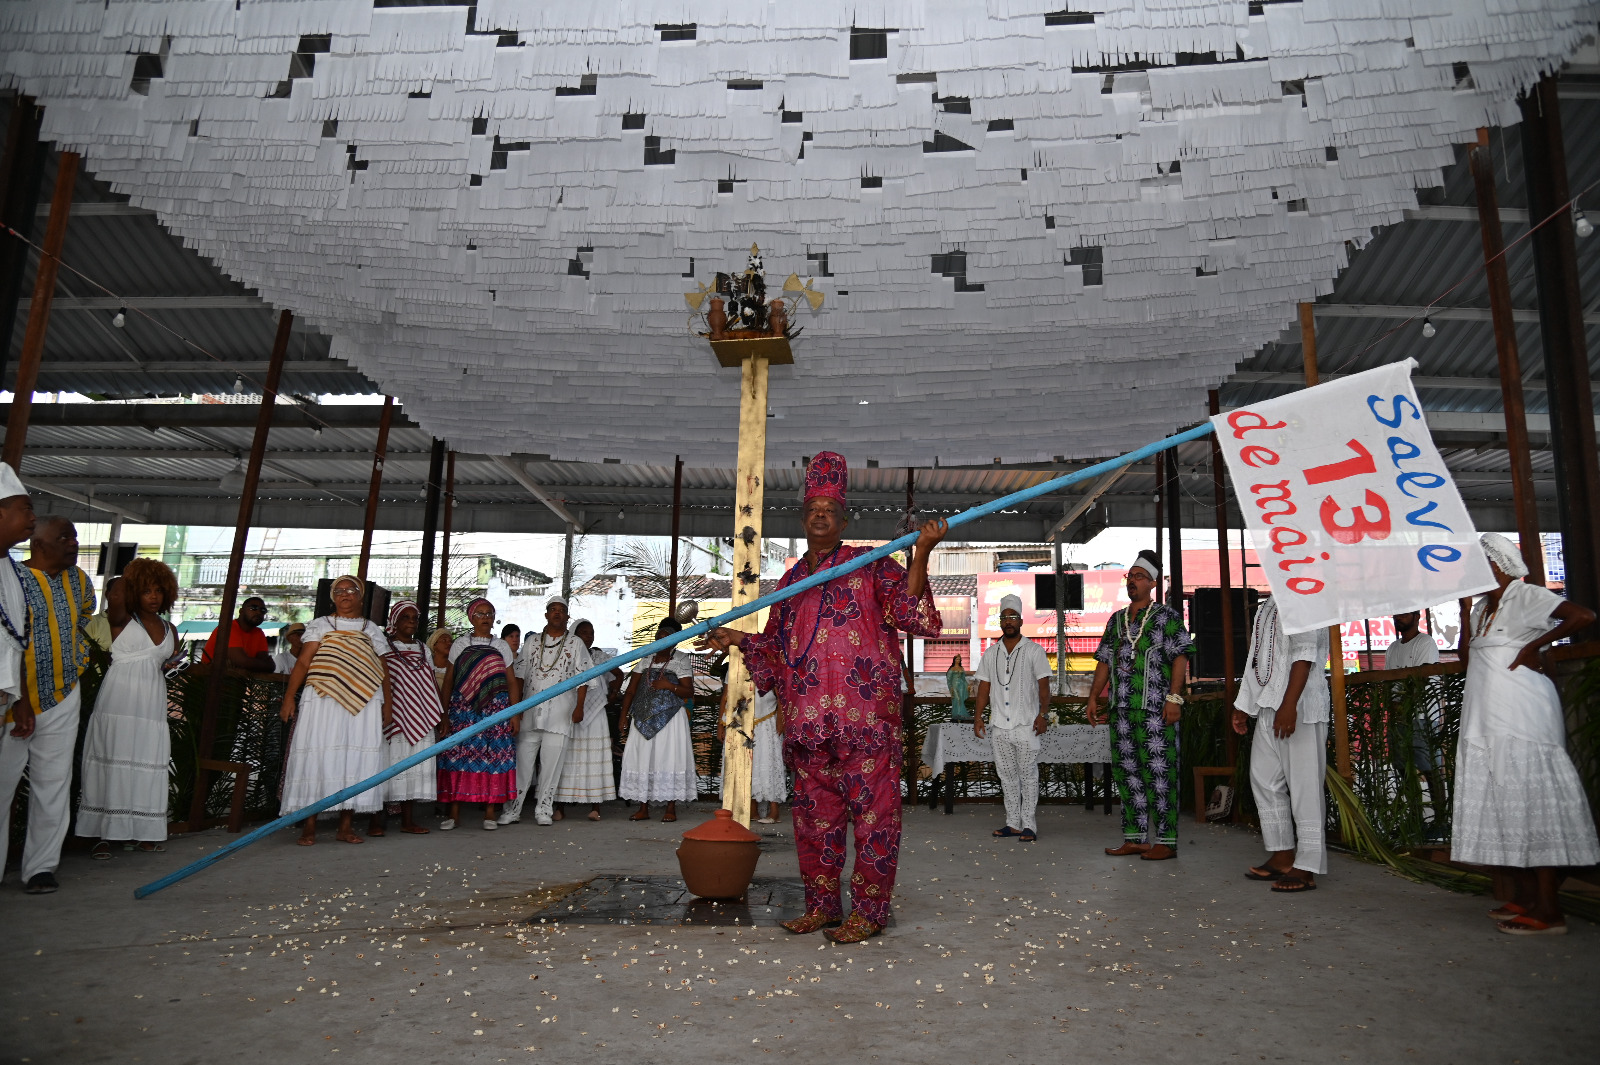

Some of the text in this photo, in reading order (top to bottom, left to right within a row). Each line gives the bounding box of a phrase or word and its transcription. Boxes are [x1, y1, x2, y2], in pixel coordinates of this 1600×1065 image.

[1302, 438, 1392, 545] 13
[1366, 394, 1463, 572] Salve
[1340, 619, 1432, 637] CARNS
